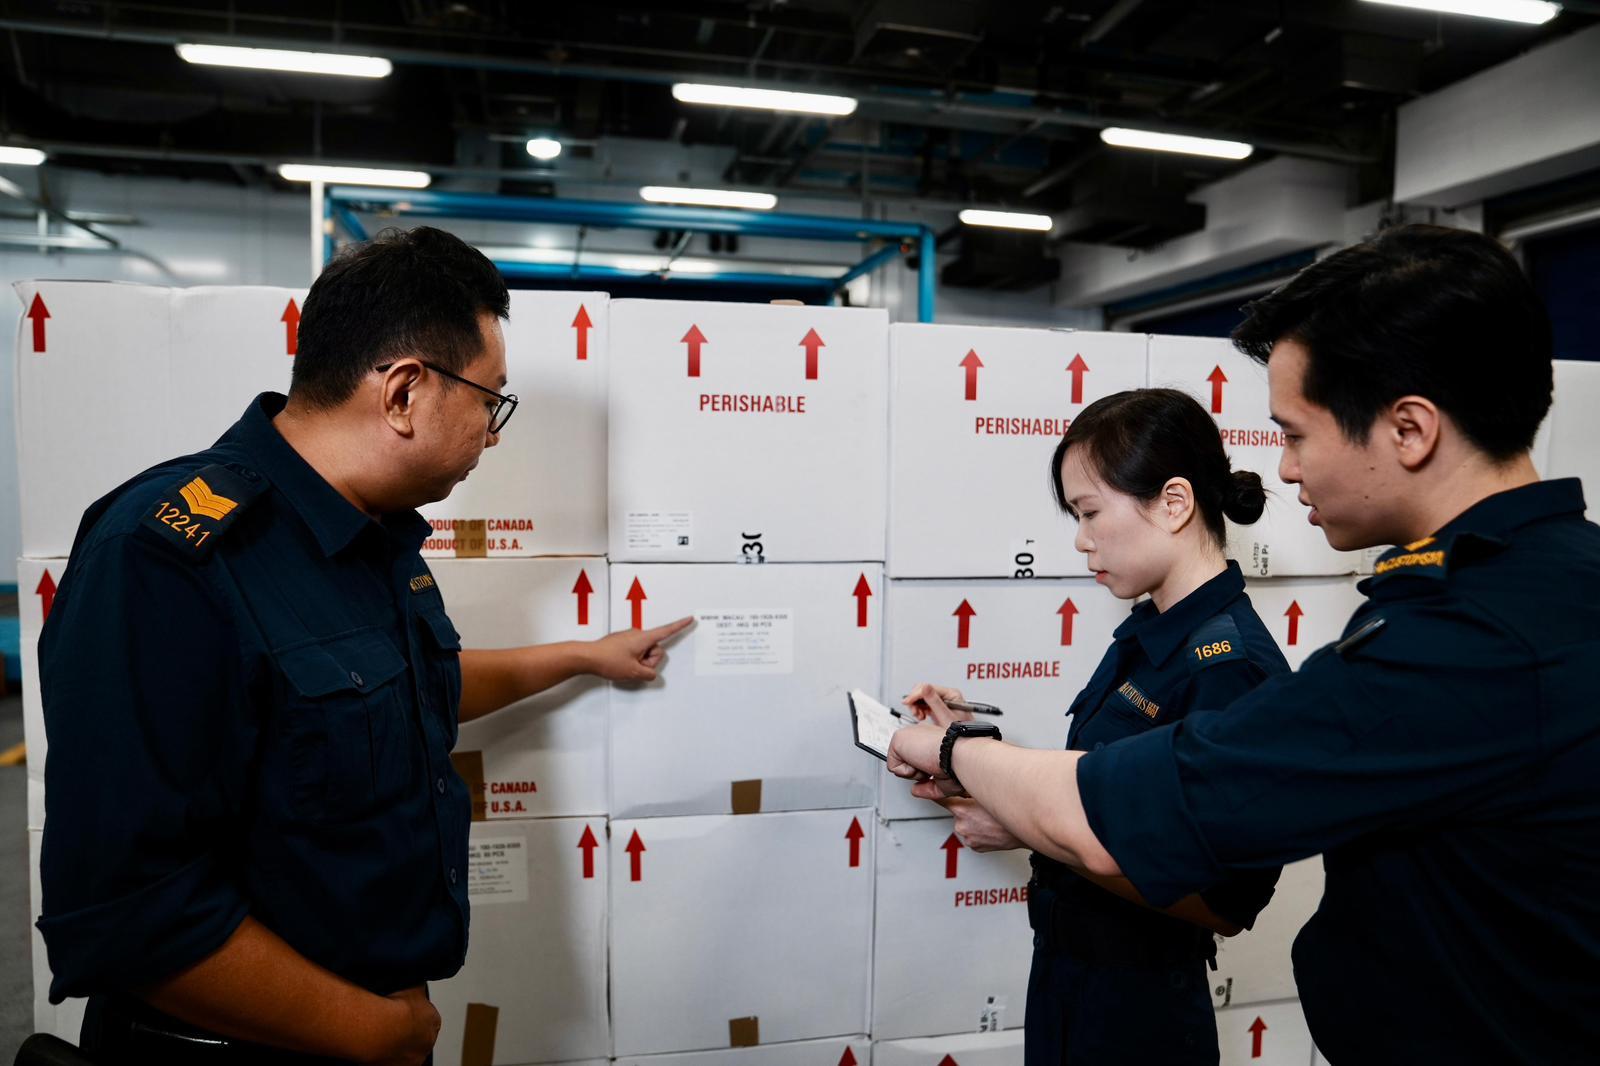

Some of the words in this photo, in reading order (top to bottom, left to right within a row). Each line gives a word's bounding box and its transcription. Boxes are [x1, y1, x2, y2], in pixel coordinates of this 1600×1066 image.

[699, 394, 806, 413] PERISHABLE
[1220, 429, 1286, 447] PERISHAB
[155, 502, 210, 547] 12241
[428, 519, 465, 531] ODUCT
[487, 520, 534, 531] CANADA
[421, 539, 465, 550] RODUCT
[487, 539, 524, 550] U.S.A.
[1194, 640, 1232, 660] 1686
[967, 661, 1060, 680] PERISHABLE
[490, 782, 537, 794] CANADA
[490, 800, 528, 813] U.S.A.
[954, 887, 1030, 908] PERISHAB
